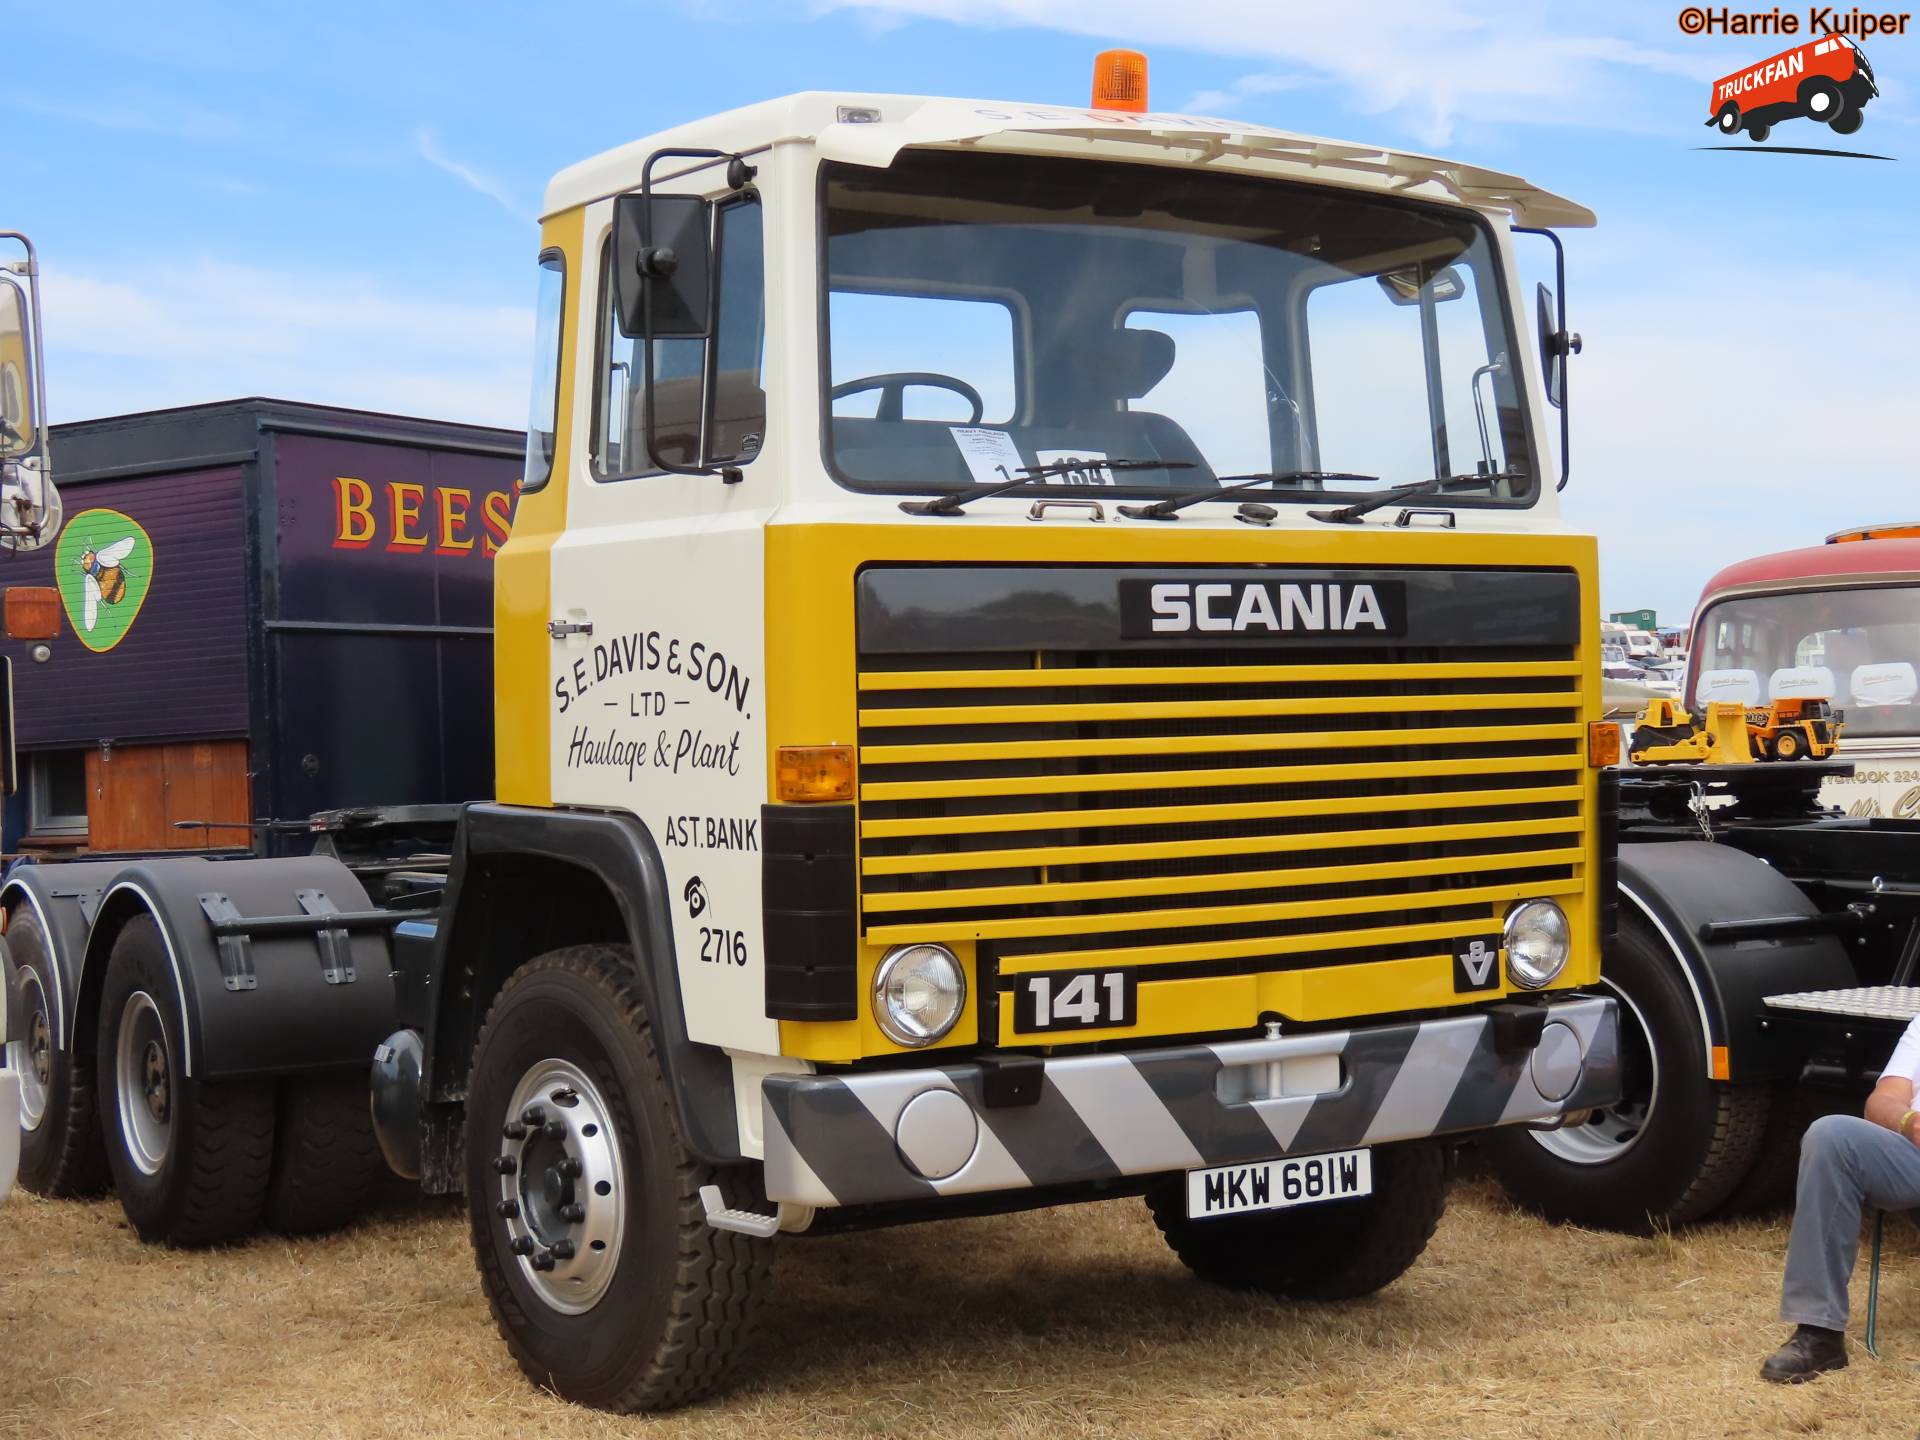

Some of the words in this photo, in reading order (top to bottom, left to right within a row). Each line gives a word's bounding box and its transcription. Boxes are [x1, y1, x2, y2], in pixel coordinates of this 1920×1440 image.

[1151, 584, 1387, 632] SCANIA
[594, 631, 660, 682] DAVIS
[667, 639, 682, 675] &
[630, 691, 666, 717] LTD
[568, 725, 647, 782] Haulage
[654, 730, 671, 768] &
[673, 729, 740, 776] Plant
[699, 927, 747, 967] 2716
[1028, 972, 1124, 1027] 141
[1204, 1166, 1270, 1211] MKW
[1282, 1154, 1358, 1200] 681W
